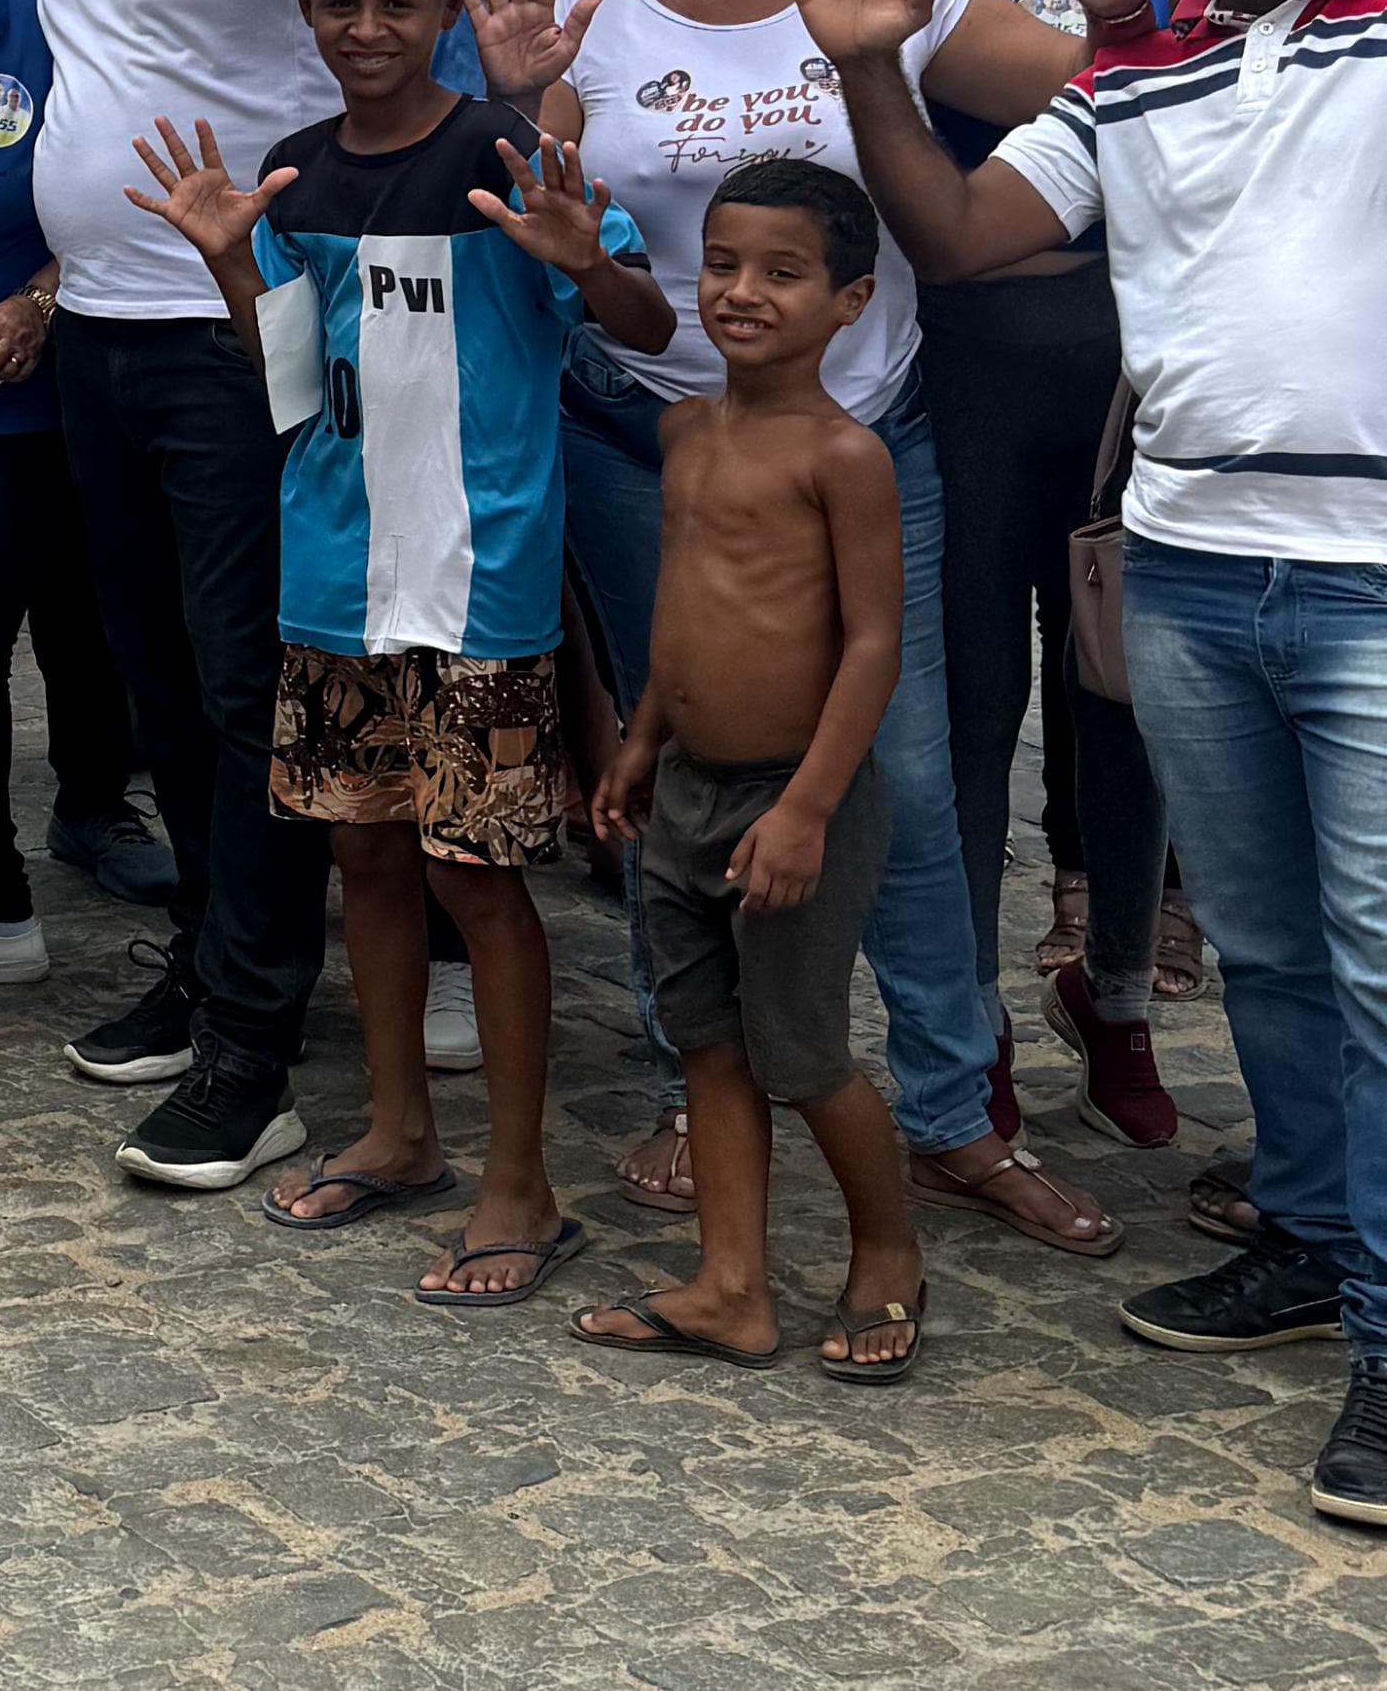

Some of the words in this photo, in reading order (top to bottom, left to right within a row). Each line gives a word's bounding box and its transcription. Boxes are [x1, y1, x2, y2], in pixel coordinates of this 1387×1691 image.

[682, 93, 730, 112] be
[741, 83, 820, 112] you
[675, 113, 726, 132] do
[739, 105, 822, 135] you
